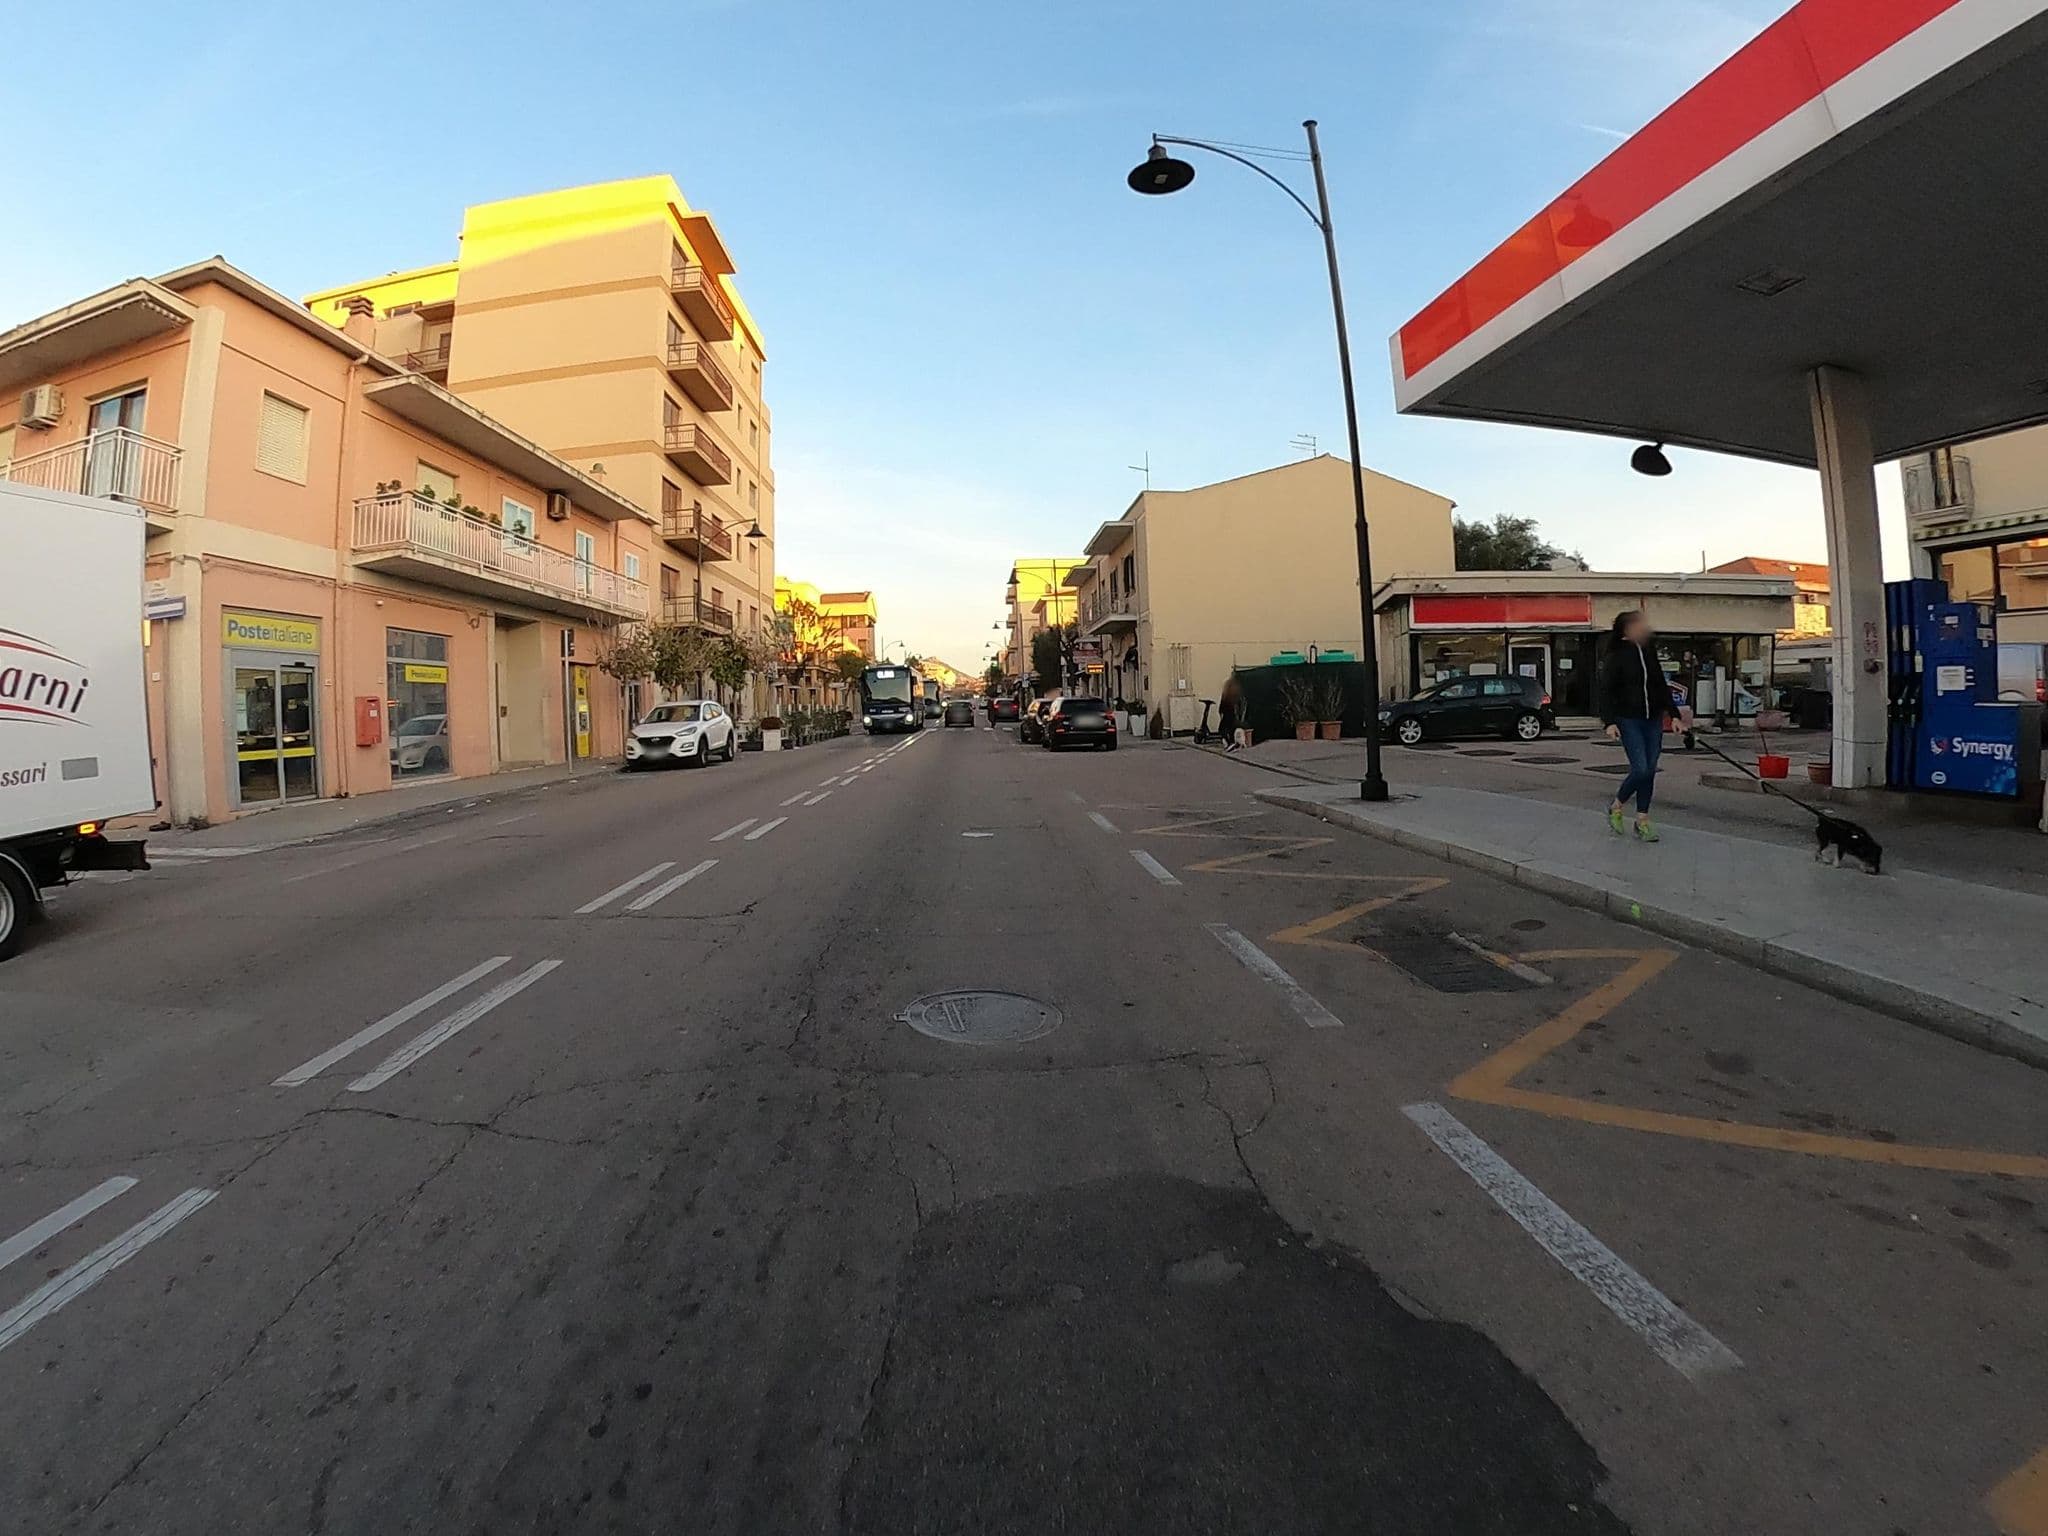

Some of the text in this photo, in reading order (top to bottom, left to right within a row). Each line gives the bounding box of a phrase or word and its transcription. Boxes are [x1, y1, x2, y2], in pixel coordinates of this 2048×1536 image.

[0, 667, 89, 713] arni
[1952, 736, 2014, 760] Synergy
[0, 762, 47, 787] ssari
